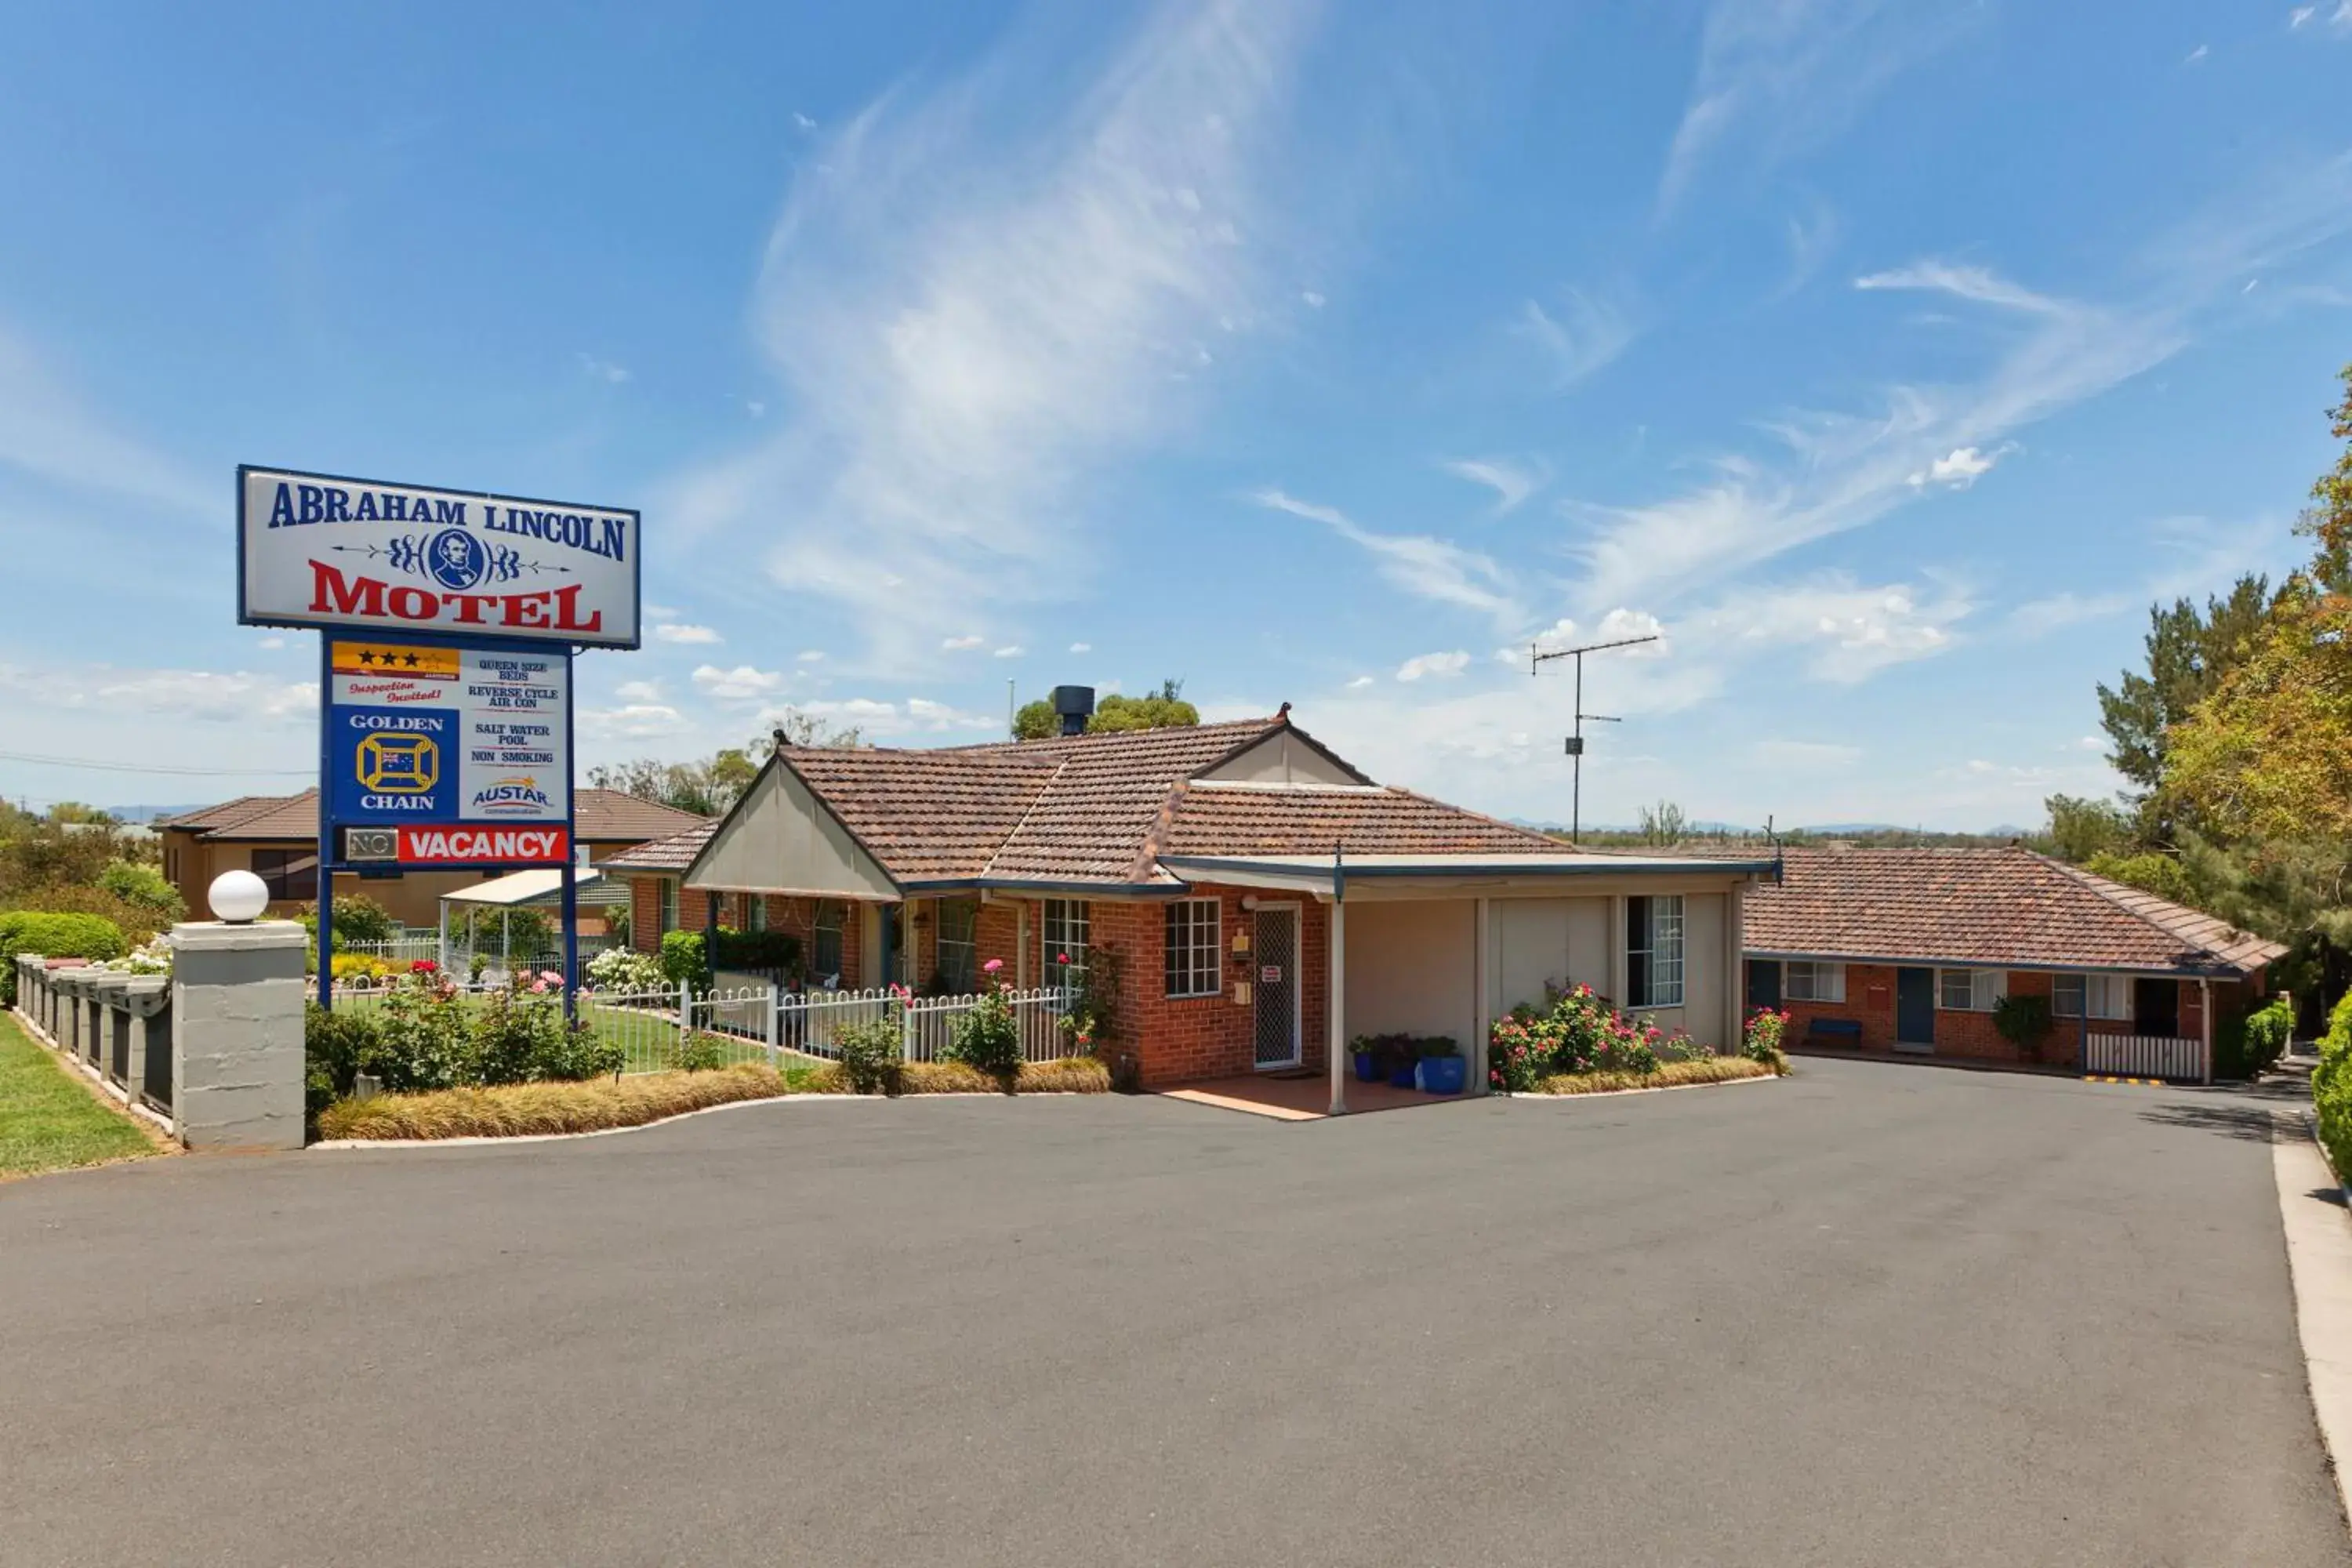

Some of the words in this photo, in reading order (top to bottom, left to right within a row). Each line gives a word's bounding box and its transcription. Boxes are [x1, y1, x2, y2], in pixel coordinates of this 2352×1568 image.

[268, 482, 467, 528] ABRAHAM
[483, 505, 626, 561] LINCOLN
[308, 559, 601, 632] MOTEL
[479, 660, 518, 670] QUEEN
[521, 662, 547, 673] SIZE
[499, 670, 528, 681] BEDS
[349, 681, 415, 694] Inspection
[469, 686, 522, 698] REVERSE
[525, 689, 558, 699] CYCLE
[488, 697, 510, 706] AIR
[514, 699, 537, 708] CON
[350, 714, 444, 731] GOLDEN
[476, 724, 505, 734] SALT
[510, 725, 550, 735] WATER
[498, 735, 527, 745] POOL
[471, 751, 495, 761] NON
[501, 753, 553, 763] SMOKING
[361, 795, 435, 810] CHAIN
[473, 786, 548, 806] AUSTAR
[351, 834, 389, 854] NO
[408, 832, 558, 858] VACANCY
